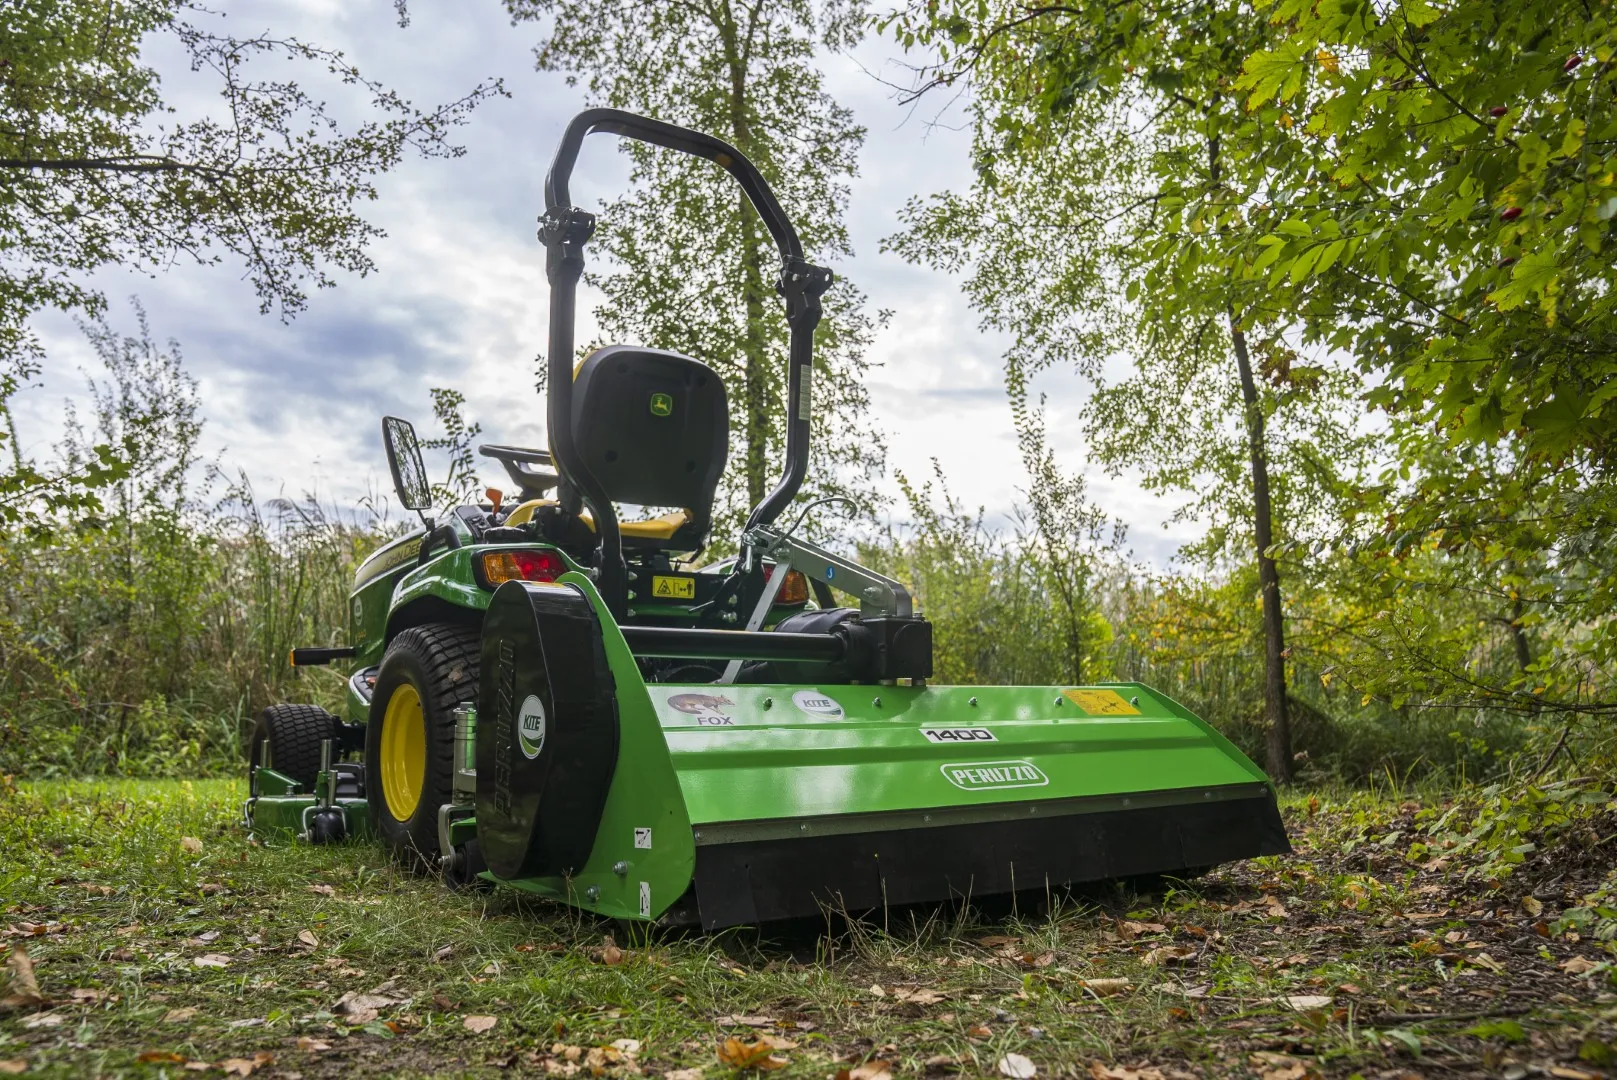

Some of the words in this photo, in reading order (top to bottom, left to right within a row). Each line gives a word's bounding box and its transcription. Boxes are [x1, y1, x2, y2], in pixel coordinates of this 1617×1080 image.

[405, 542, 421, 557] DEE
[802, 699, 831, 708] KITE
[523, 714, 542, 732] KITE
[697, 716, 734, 726] FOX
[926, 729, 993, 741] 1400
[951, 765, 1039, 785] PERUZZO
